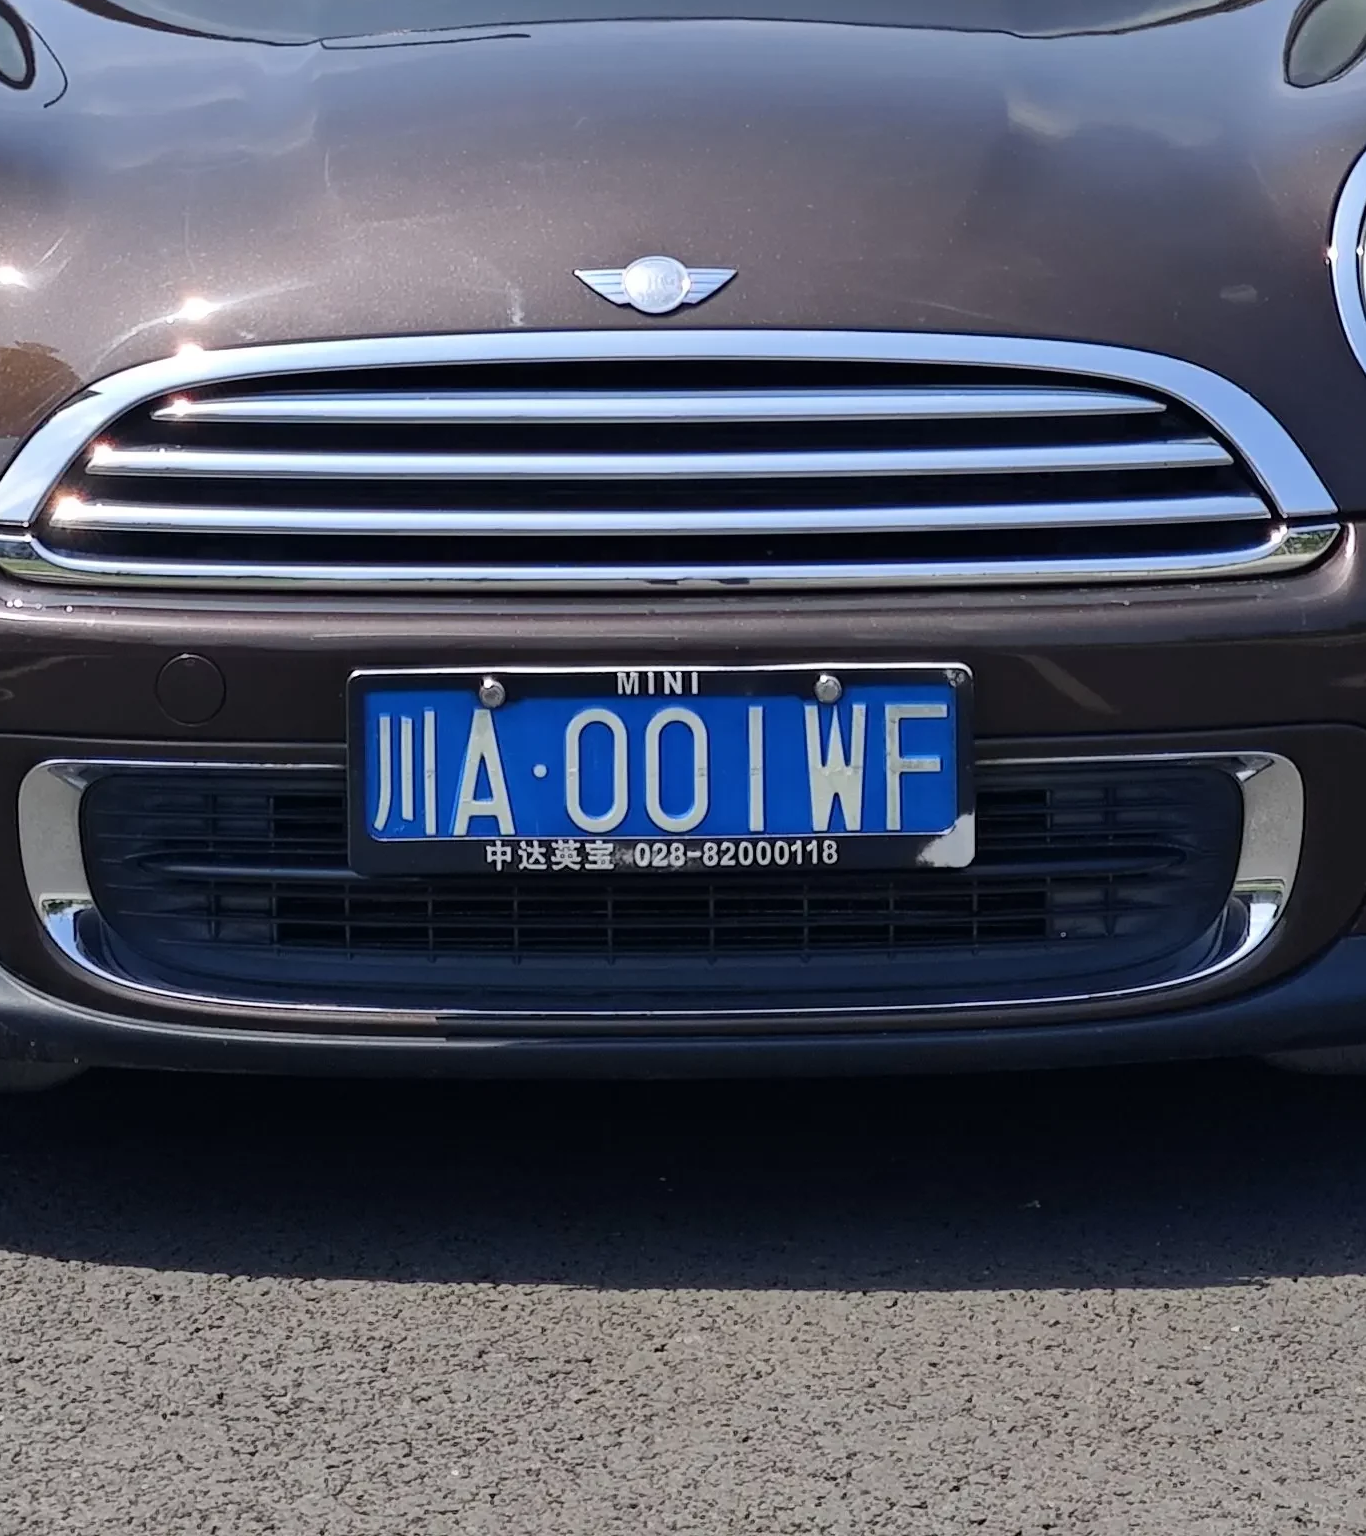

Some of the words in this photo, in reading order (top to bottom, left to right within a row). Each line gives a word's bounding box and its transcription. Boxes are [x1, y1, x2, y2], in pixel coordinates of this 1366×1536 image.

[616, 671, 700, 696] MINI
[485, 839, 616, 872] 中达英宝
[633, 840, 839, 868] 028-82000118
